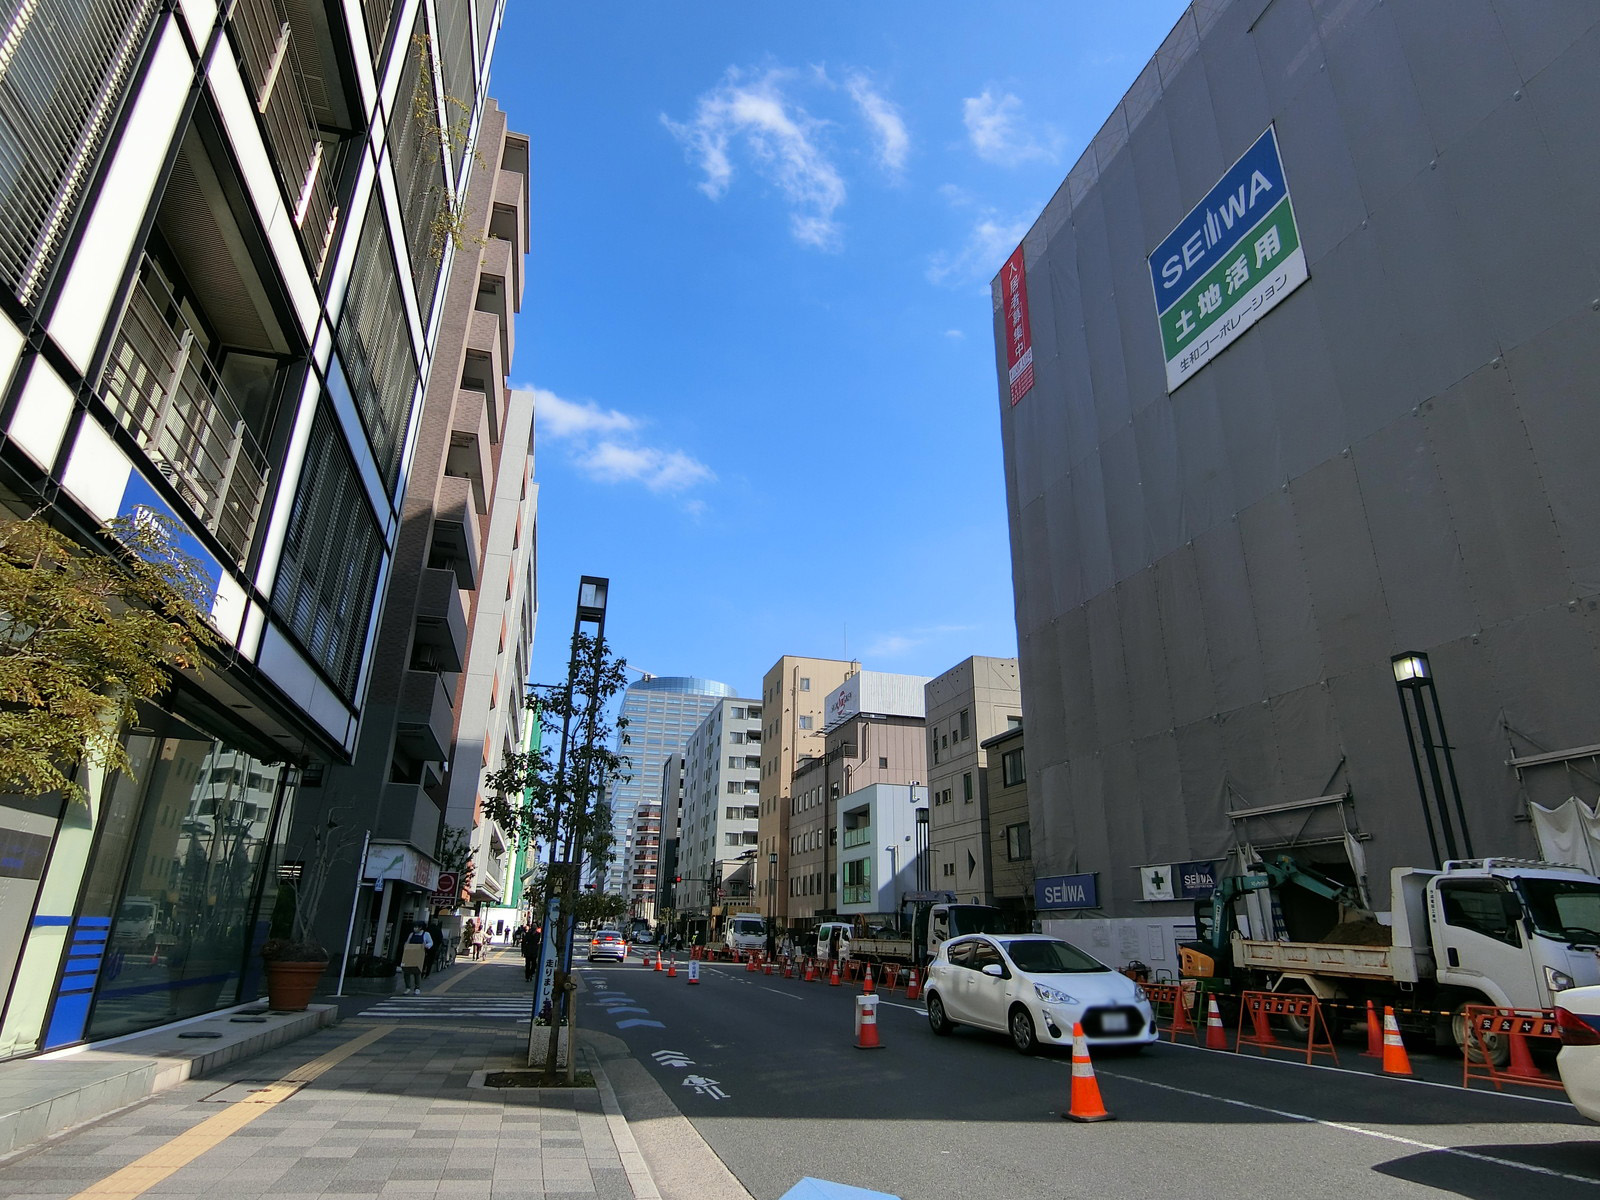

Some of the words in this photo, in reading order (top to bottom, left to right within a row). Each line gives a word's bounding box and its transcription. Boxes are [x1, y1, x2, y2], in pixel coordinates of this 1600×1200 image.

[1161, 170, 1273, 289] SEIWA
[1174, 225, 1282, 343] 土地活用
[1179, 273, 1288, 374] 生和コーポレーション
[1044, 879, 1086, 904] SEIWA
